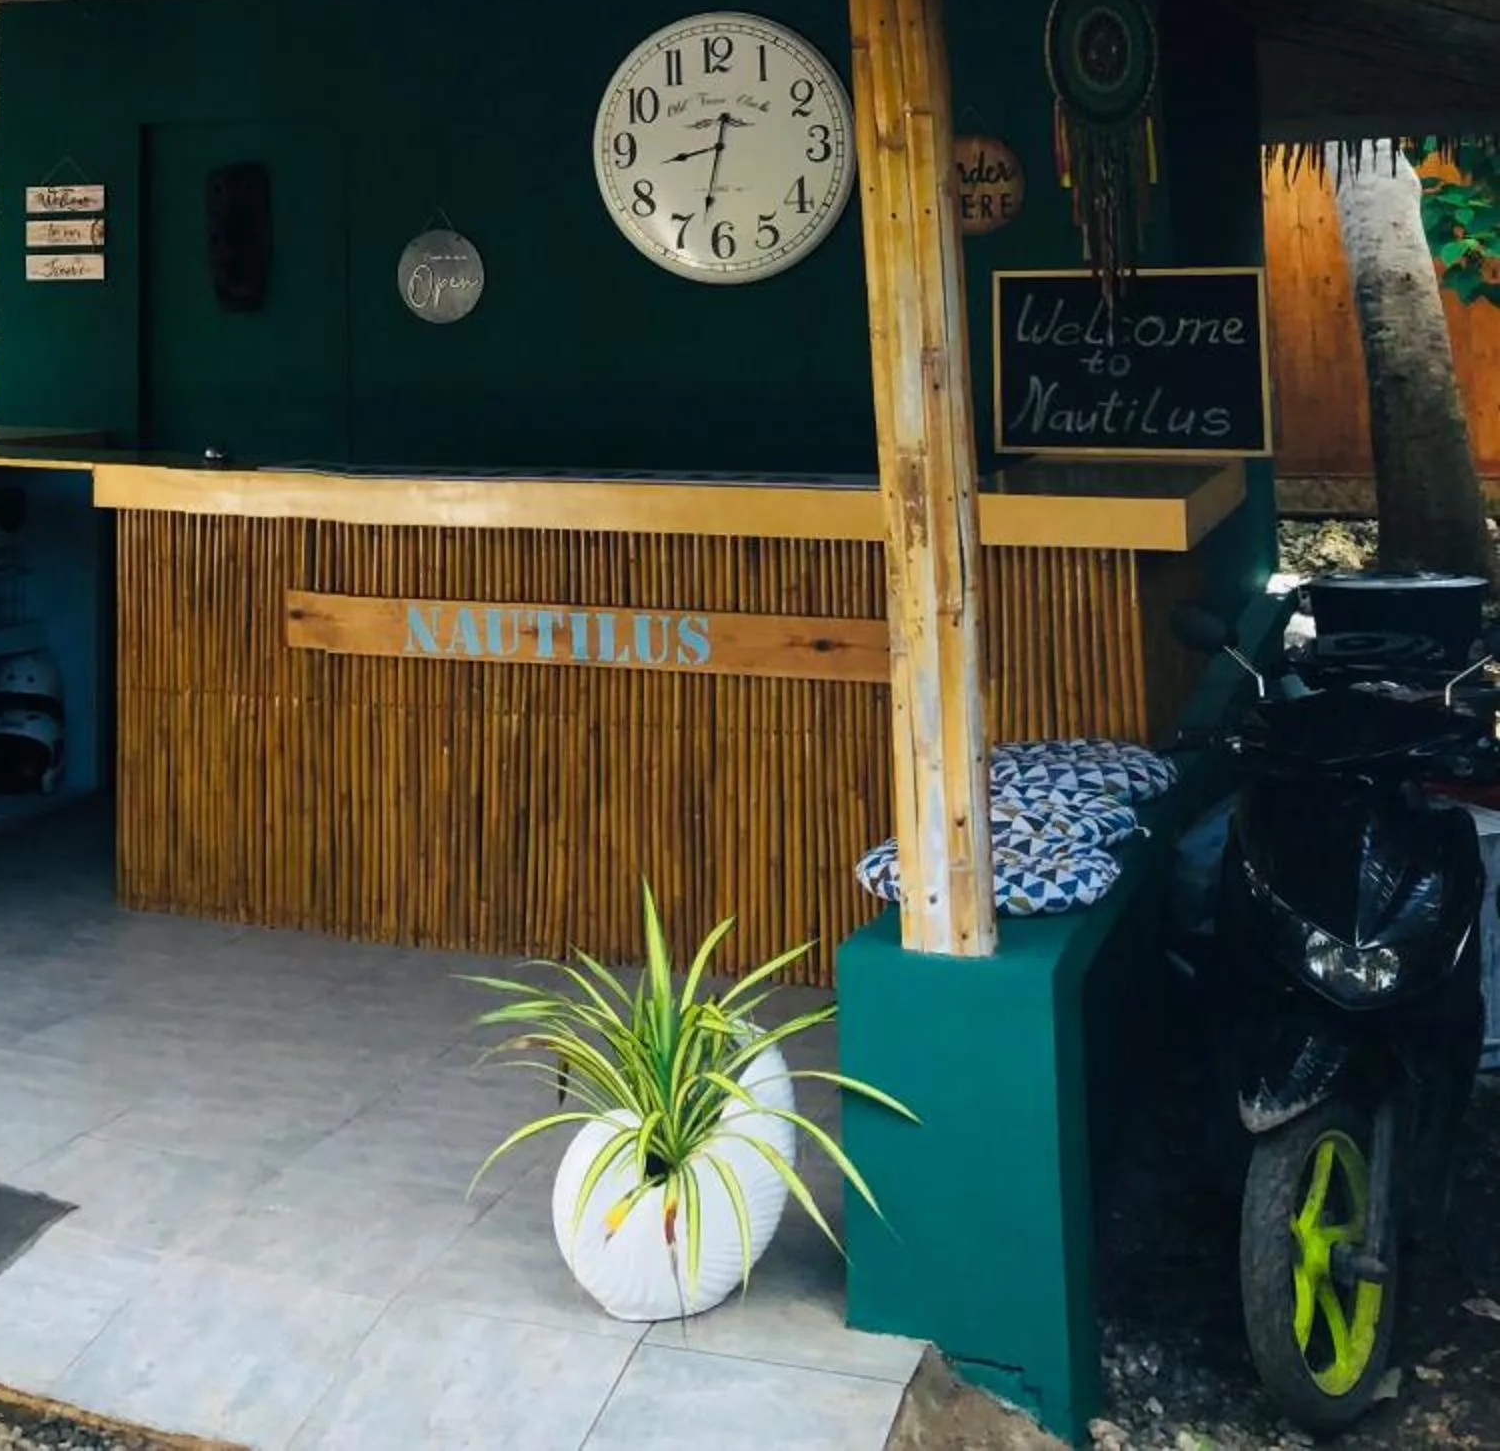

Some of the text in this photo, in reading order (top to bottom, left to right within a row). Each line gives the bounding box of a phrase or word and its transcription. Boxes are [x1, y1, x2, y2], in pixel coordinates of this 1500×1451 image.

[665, 48, 684, 86] 11
[703, 36, 733, 73] 12
[758, 44, 767, 82] 1
[628, 86, 660, 124] 10
[790, 79, 815, 117] 2
[613, 132, 637, 169] 9
[805, 124, 831, 163] 3
[957, 151, 1012, 183] rder
[631, 179, 656, 217] 8
[784, 175, 815, 214] 4
[961, 193, 1012, 219] ERE
[671, 213, 695, 249] 7
[711, 221, 736, 260] 6
[755, 211, 780, 249] 5
[407, 264, 480, 308] Open
[1016, 293, 1247, 347] Welome
[1079, 350, 1131, 377] to
[1008, 375, 1232, 436] Nautilus
[404, 603, 712, 666] NAUTILUS
